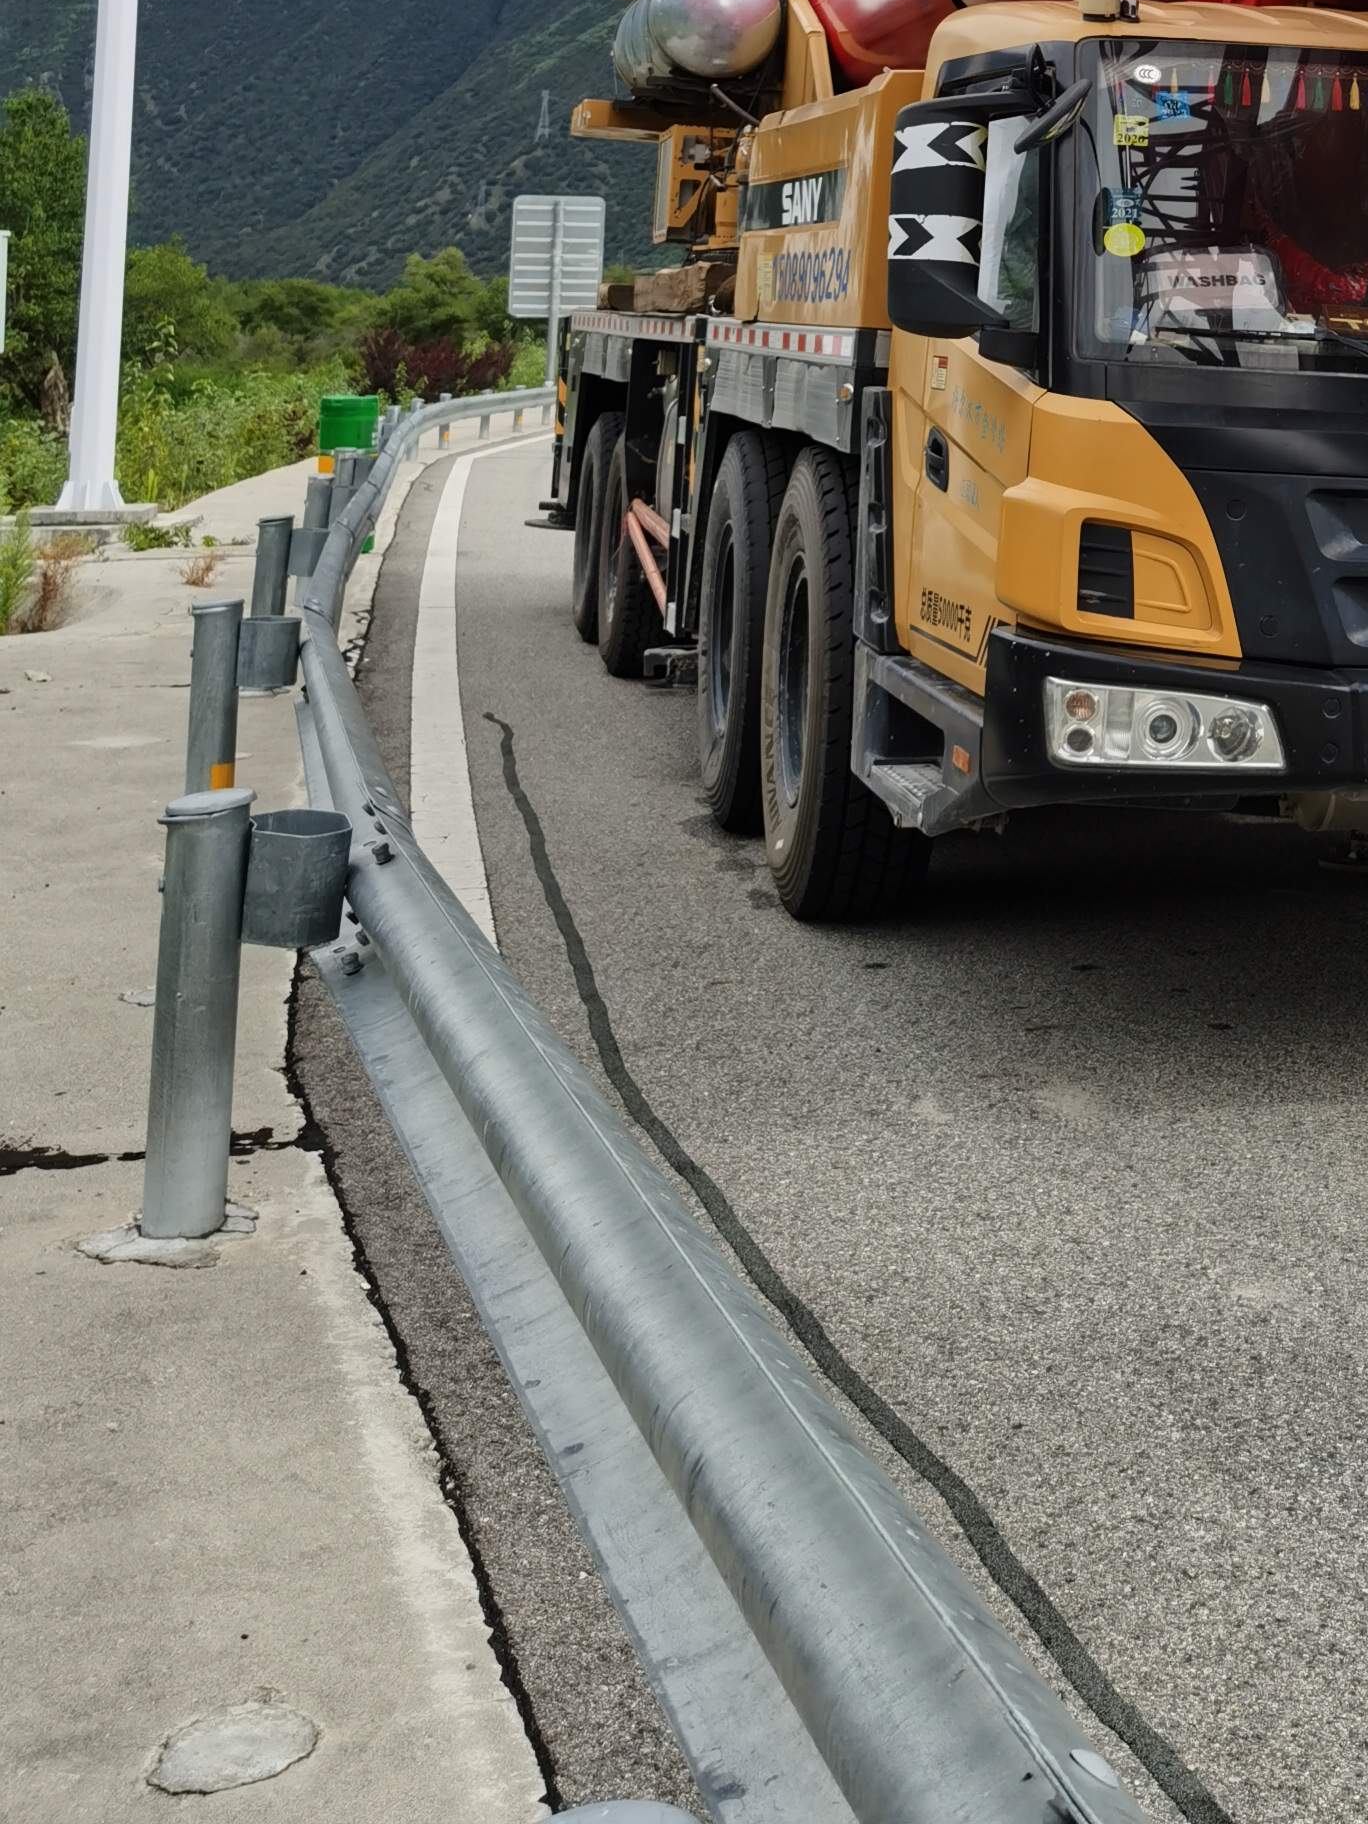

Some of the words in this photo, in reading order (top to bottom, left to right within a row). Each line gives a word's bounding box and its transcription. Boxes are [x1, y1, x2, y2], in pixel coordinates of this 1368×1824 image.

[782, 176, 823, 225] SANY
[1111, 207, 1138, 218] 2021
[1167, 274, 1266, 288] WASHBAG
